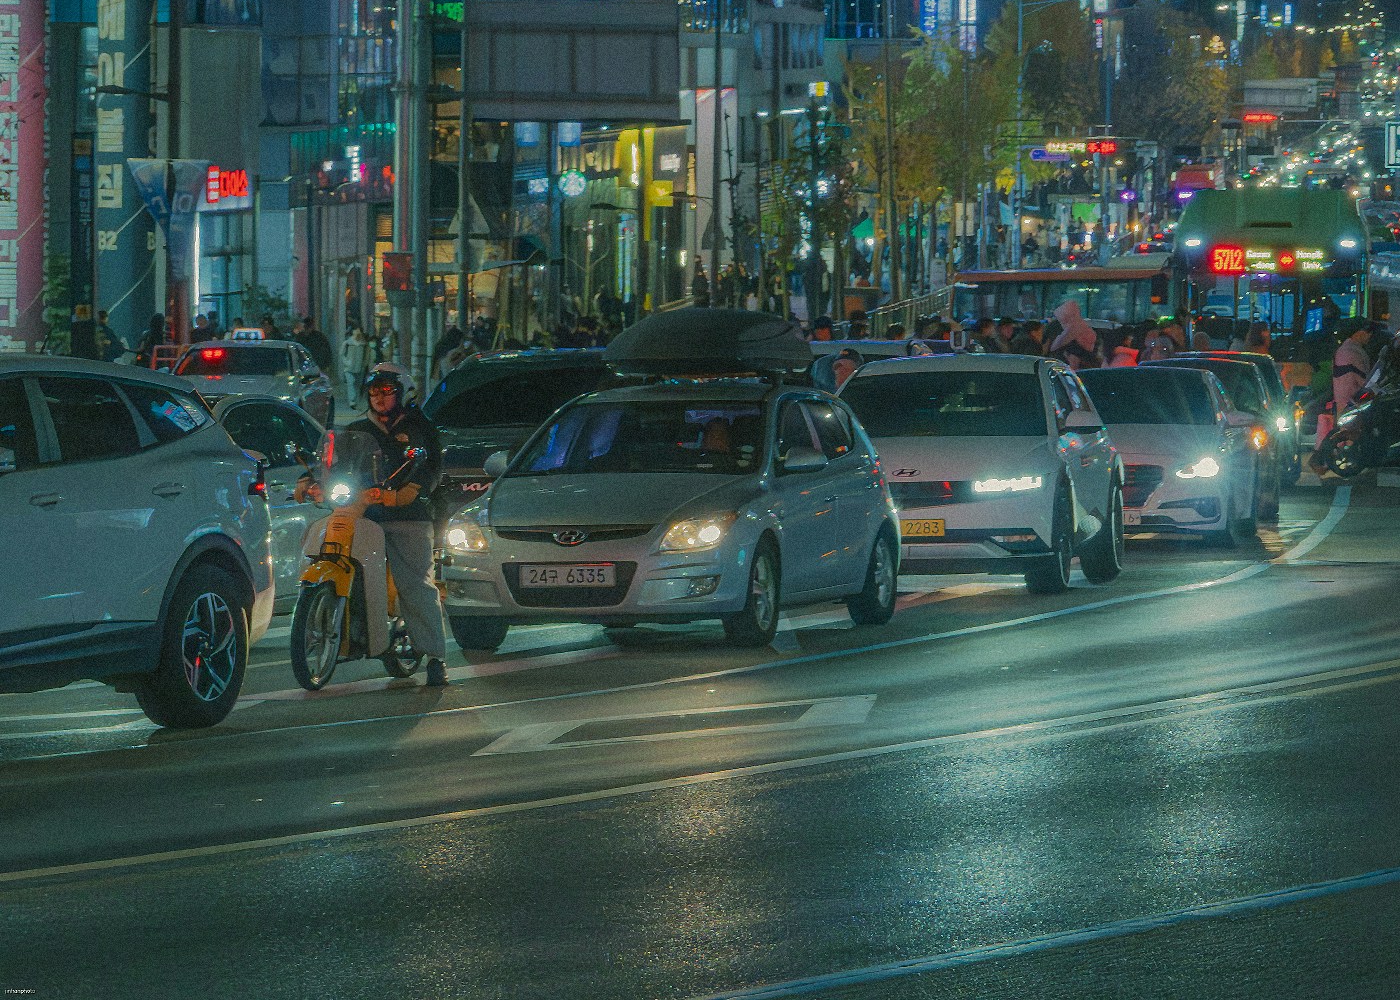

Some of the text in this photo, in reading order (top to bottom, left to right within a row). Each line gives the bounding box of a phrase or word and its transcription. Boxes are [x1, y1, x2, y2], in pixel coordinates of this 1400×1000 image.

[1214, 249, 1243, 270] 5712
[905, 520, 940, 536] 2283
[565, 568, 606, 585] 6335
